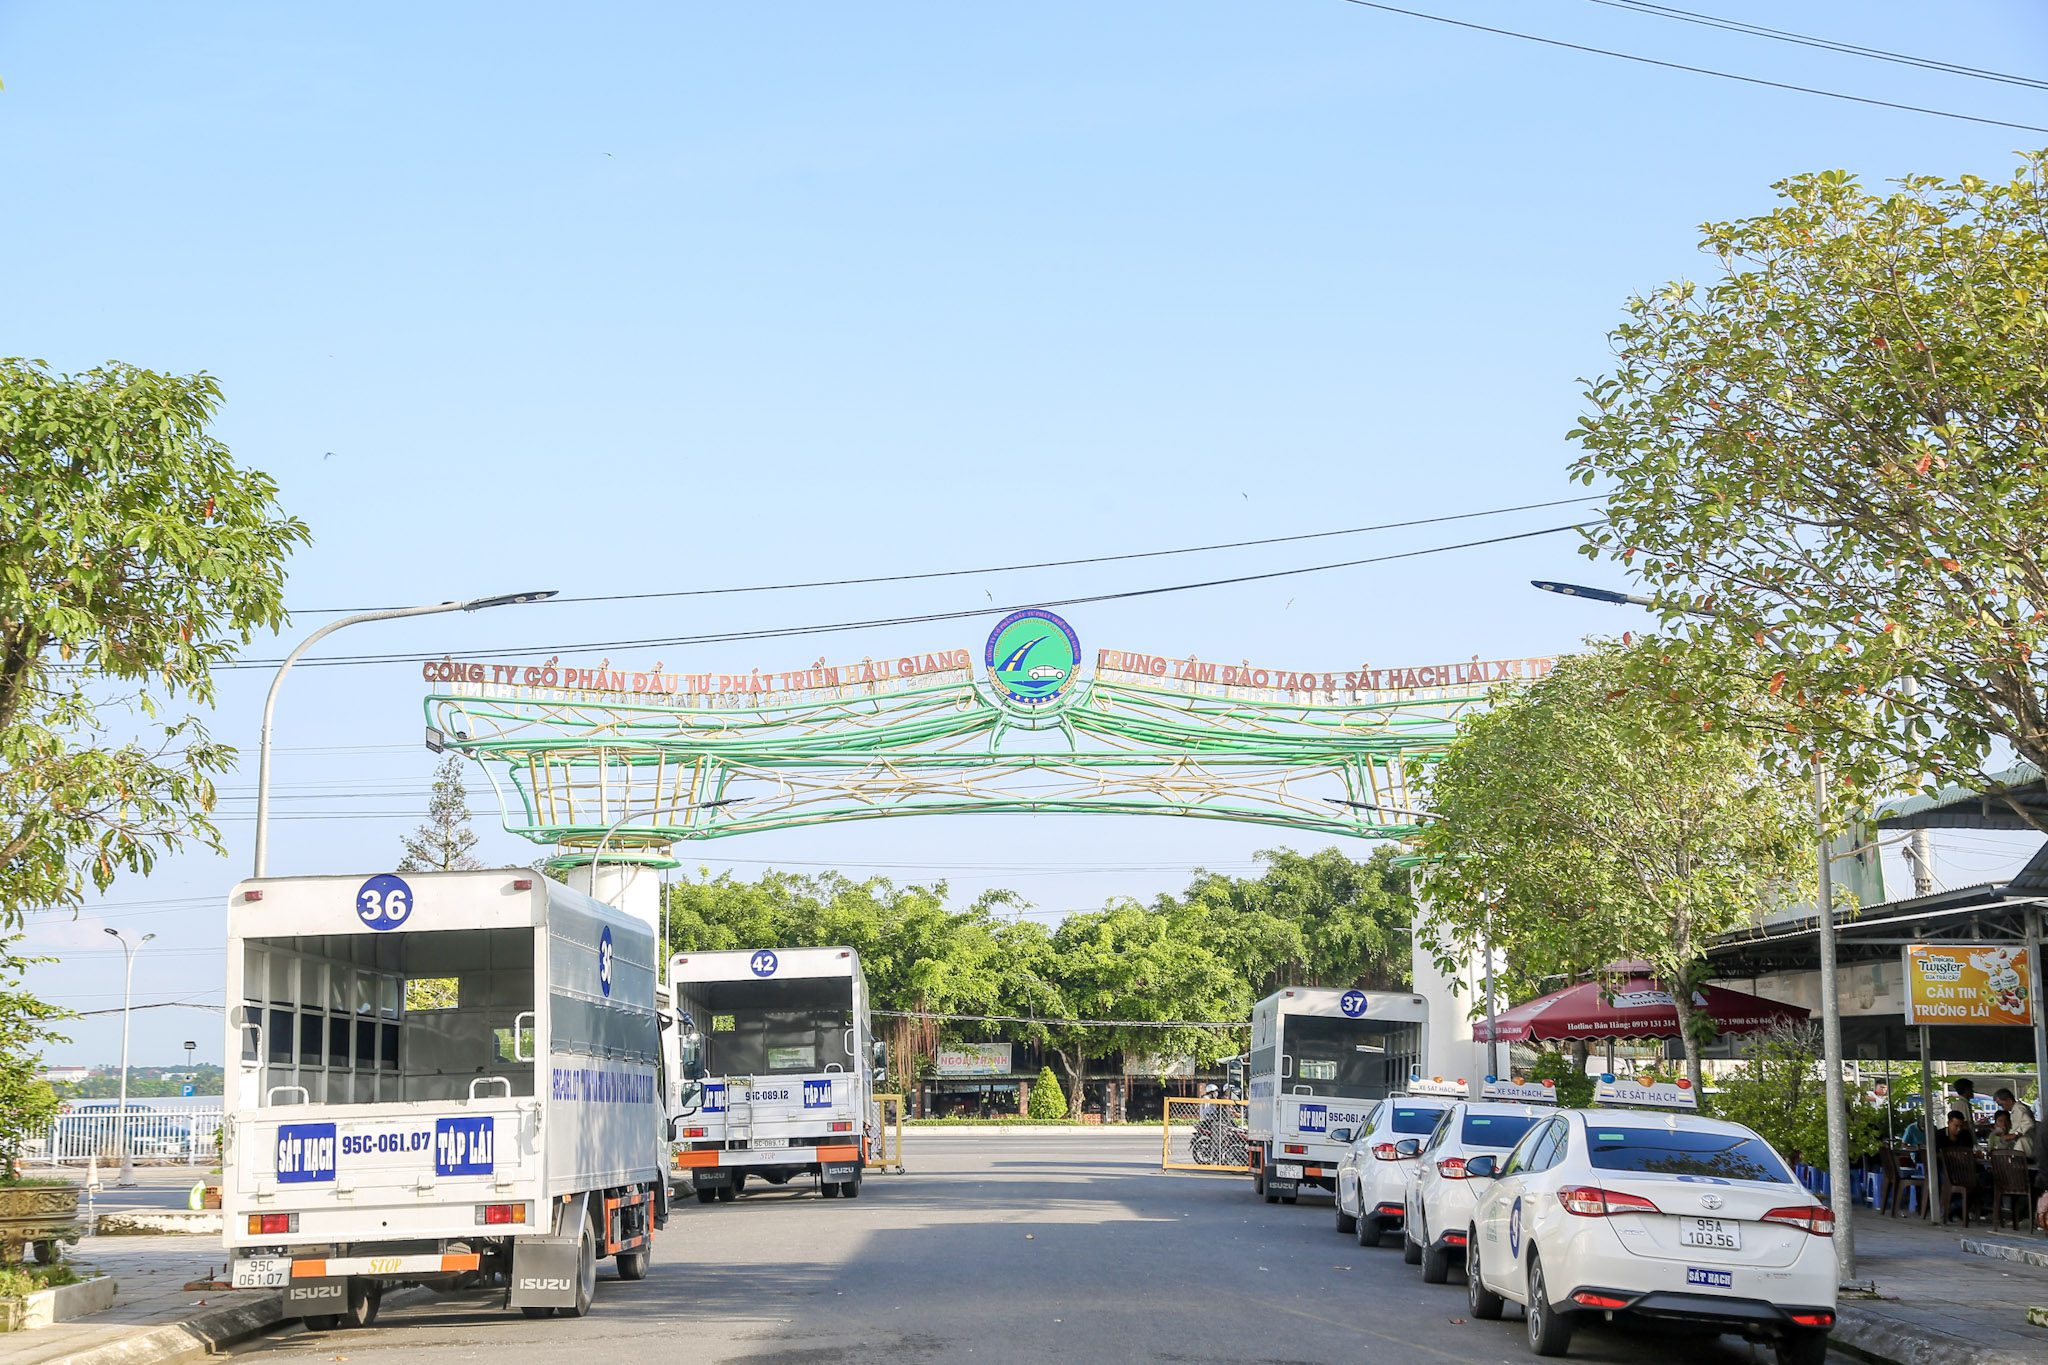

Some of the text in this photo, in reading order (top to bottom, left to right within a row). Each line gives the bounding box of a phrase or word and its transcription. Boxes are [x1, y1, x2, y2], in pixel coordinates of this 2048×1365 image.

[423, 655, 484, 683] CÔNG
[492, 665, 518, 685] TY
[524, 655, 558, 687] CỔ
[564, 658, 625, 692] PHẦN
[632, 661, 678, 693] ĐẦU
[686, 672, 712, 694] TƯ
[719, 667, 773, 694] PHÁT
[781, 656, 840, 692] TRIỂN
[846, 656, 890, 688] HẬU
[898, 649, 971, 677] GIANG
[1099, 649, 1167, 677] TRUNG
[1174, 654, 1216, 682] TÂM
[1222, 659, 1269, 688] ĐÀO
[1275, 671, 1316, 696] TẠO
[1322, 673, 1337, 692] &
[1345, 663, 1381, 691] SÁT
[1389, 666, 1449, 695] HẠCH
[1456, 654, 1489, 683] LÁI
[1495, 660, 1522, 680] XE
[361, 890, 407, 921] 36
[601, 940, 612, 984] 36
[752, 955, 774, 972] 42
[1931, 955, 1954, 963] Tropicana
[1919, 960, 1964, 974] Twister
[1926, 985, 1977, 999] CĂN TIN
[1343, 996, 1364, 1012] 37
[1915, 1002, 1989, 1017] TRƯỜNG LÁI
[1609, 1021, 1631, 1030] Hàng:
[1632, 1020, 1648, 1028] 0919
[1663, 1019, 1676, 1027] 314
[183, 1085, 192, 1096] P
[703, 1087, 714, 1107] ÁT
[1616, 1089, 1627, 1099] XE
[342, 1131, 431, 1155] 95C-061.07
[437, 1123, 493, 1172] TẬP LÁI
[278, 1132, 334, 1178] SÁT HẠCH
[829, 1166, 854, 1174] ISUZU
[1697, 1220, 1722, 1232] 95A
[1689, 1232, 1734, 1247] 103.56
[250, 1260, 274, 1272] 95C
[367, 1258, 402, 1273] STOP
[239, 1273, 283, 1286] 061.07
[519, 1277, 571, 1290] ISUZU
[1688, 1270, 1731, 1286] SÁT HẠCH
[290, 1285, 342, 1300] ISUZU
